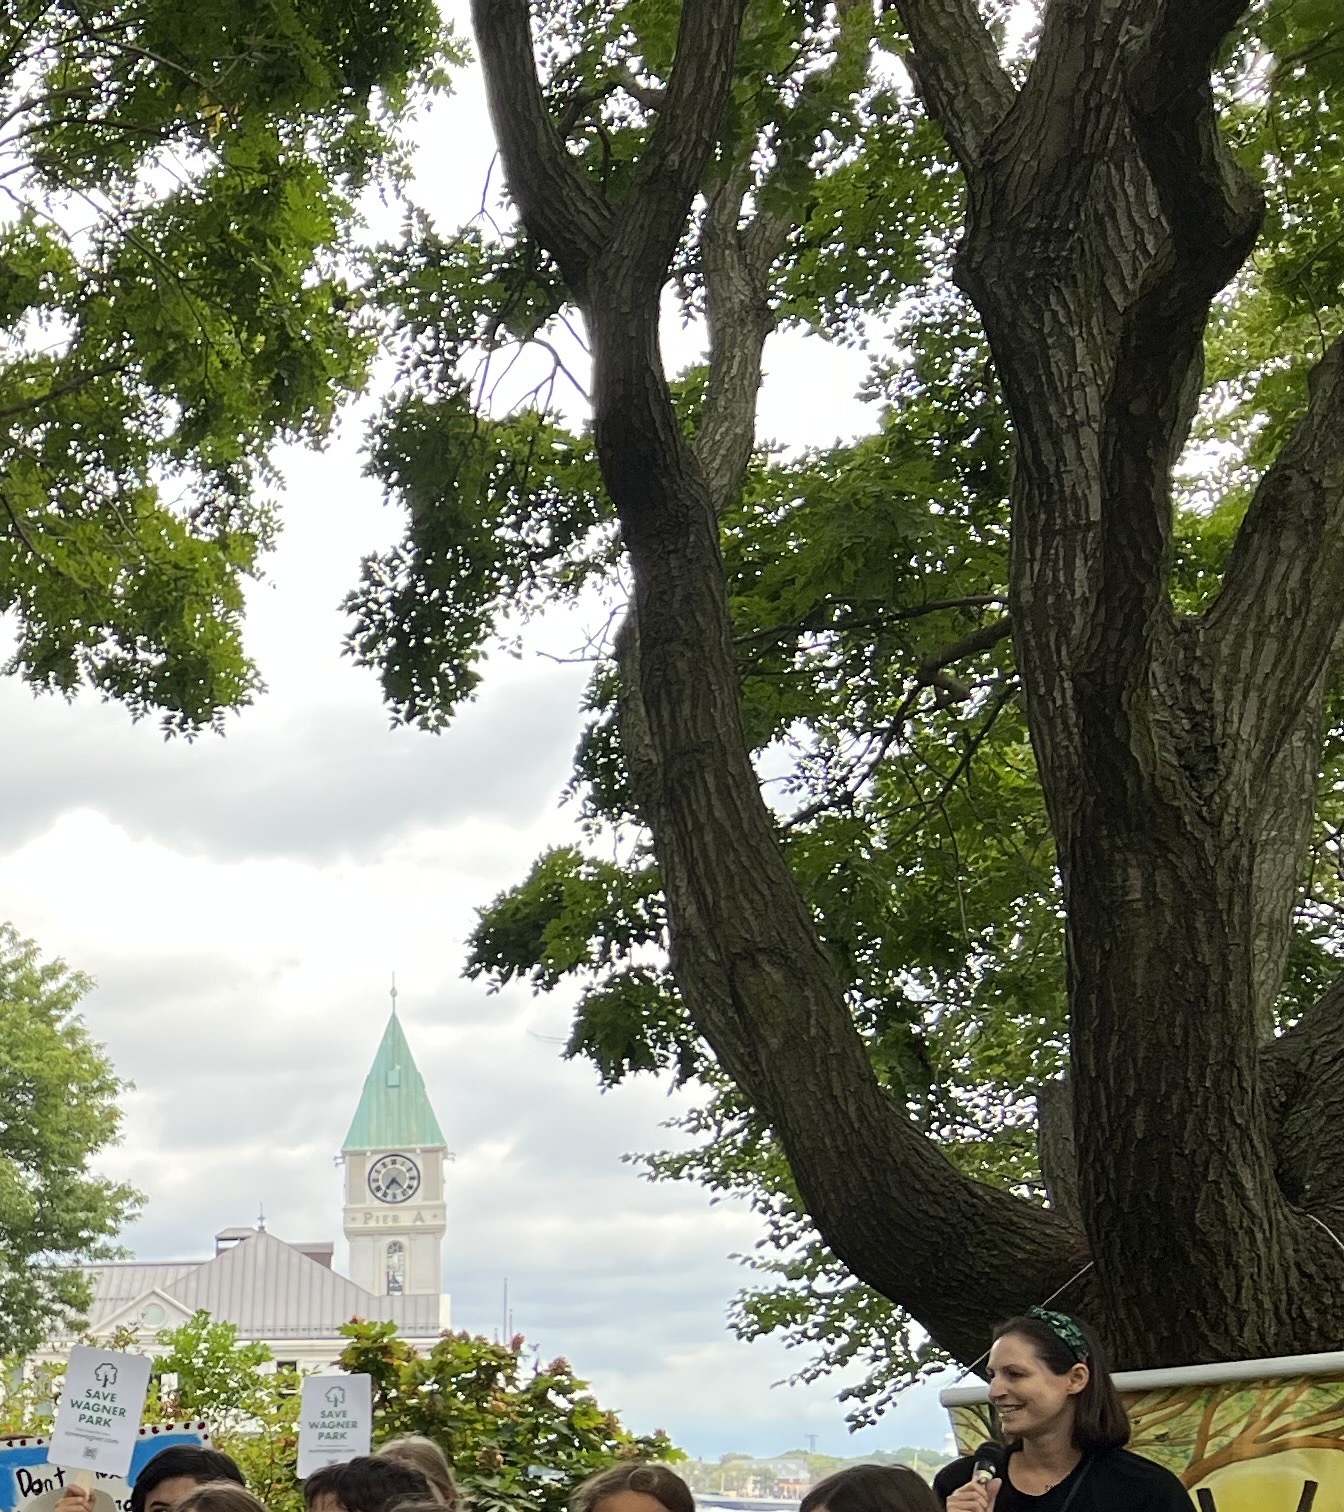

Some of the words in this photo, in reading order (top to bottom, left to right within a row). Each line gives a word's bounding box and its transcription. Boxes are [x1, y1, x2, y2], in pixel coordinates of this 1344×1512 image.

[413, 1211, 425, 1224] A
[84, 1388, 117, 1403] SAVE
[70, 1399, 127, 1418] WAGNER
[320, 1410, 347, 1419] SAVE
[78, 1413, 113, 1428] PARK
[308, 1421, 358, 1430] WAGNER
[318, 1432, 348, 1441] PARK
